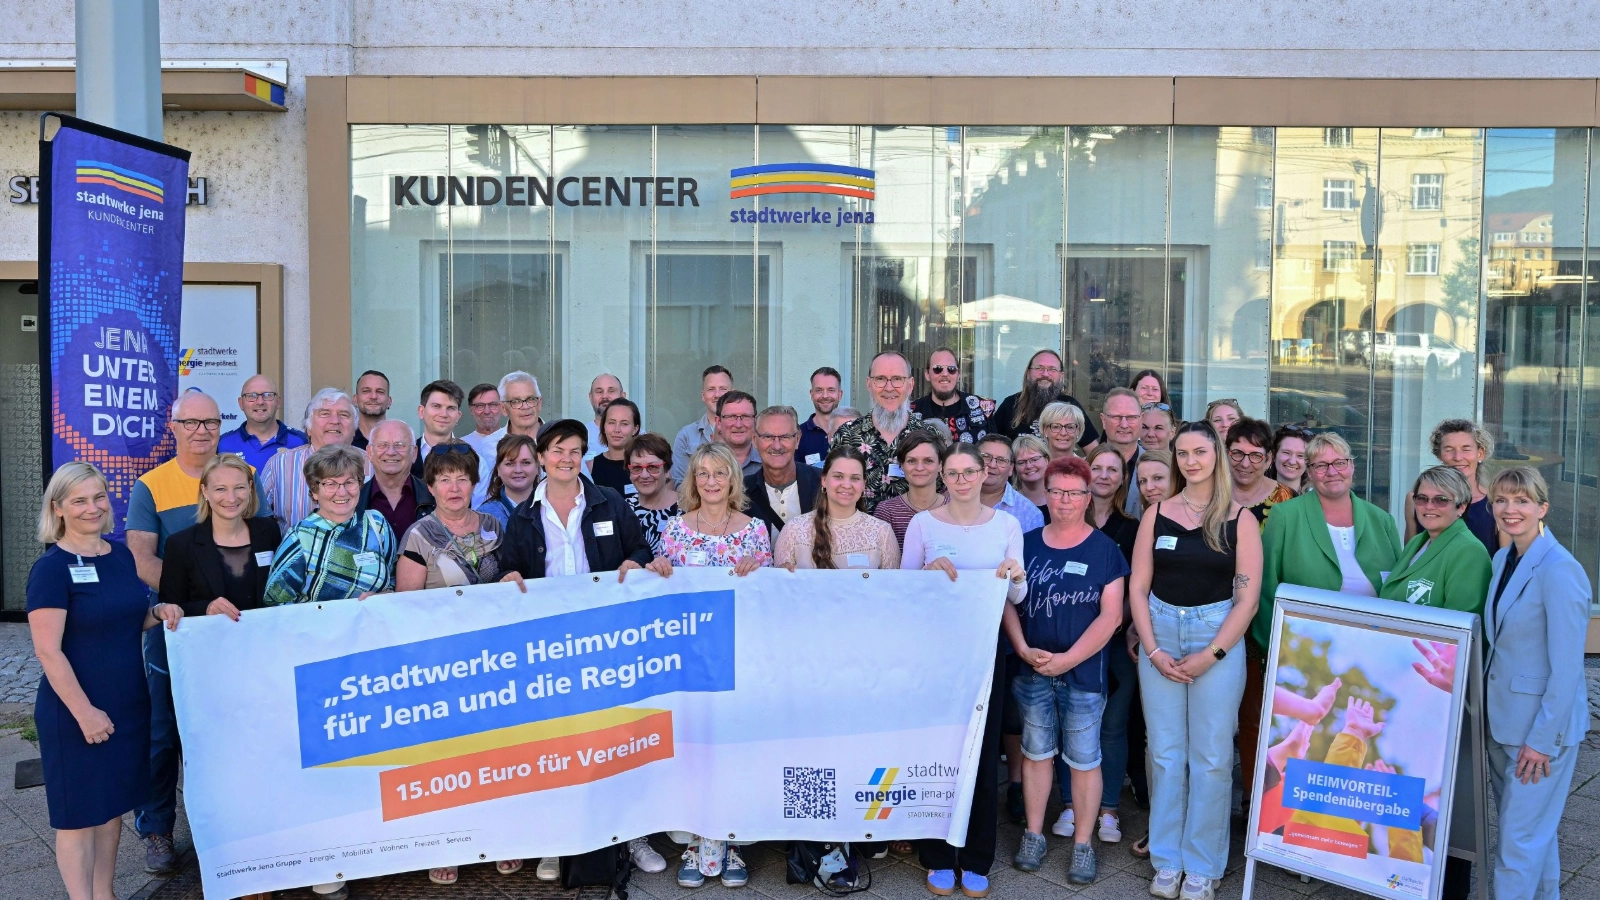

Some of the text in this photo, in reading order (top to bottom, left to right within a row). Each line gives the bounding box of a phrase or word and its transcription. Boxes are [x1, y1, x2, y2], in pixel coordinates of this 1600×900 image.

[76, 190, 136, 215] stadtwerke
[138, 204, 164, 221] jena
[394, 175, 700, 207] KUNDENCENTER
[730, 205, 875, 228] stadtwerke jena
[197, 347, 238, 356] stadtwerke
[83, 354, 157, 384] UNTER
[84, 383, 159, 411] EINEM
[323, 653, 682, 741] für Jena und die Region
[396, 732, 661, 801] 15.000 Euro für Vereine
[854, 786, 917, 806] energie
[1307, 773, 1398, 798] HEIMVORTEIL-
[907, 811, 946, 819] STADTWERKE
[1293, 786, 1411, 817] Spendenübergabe
[216, 835, 472, 879] Stadtwerke Jena Gruppe Energie Mobilität Wohnen Freizeit Services
